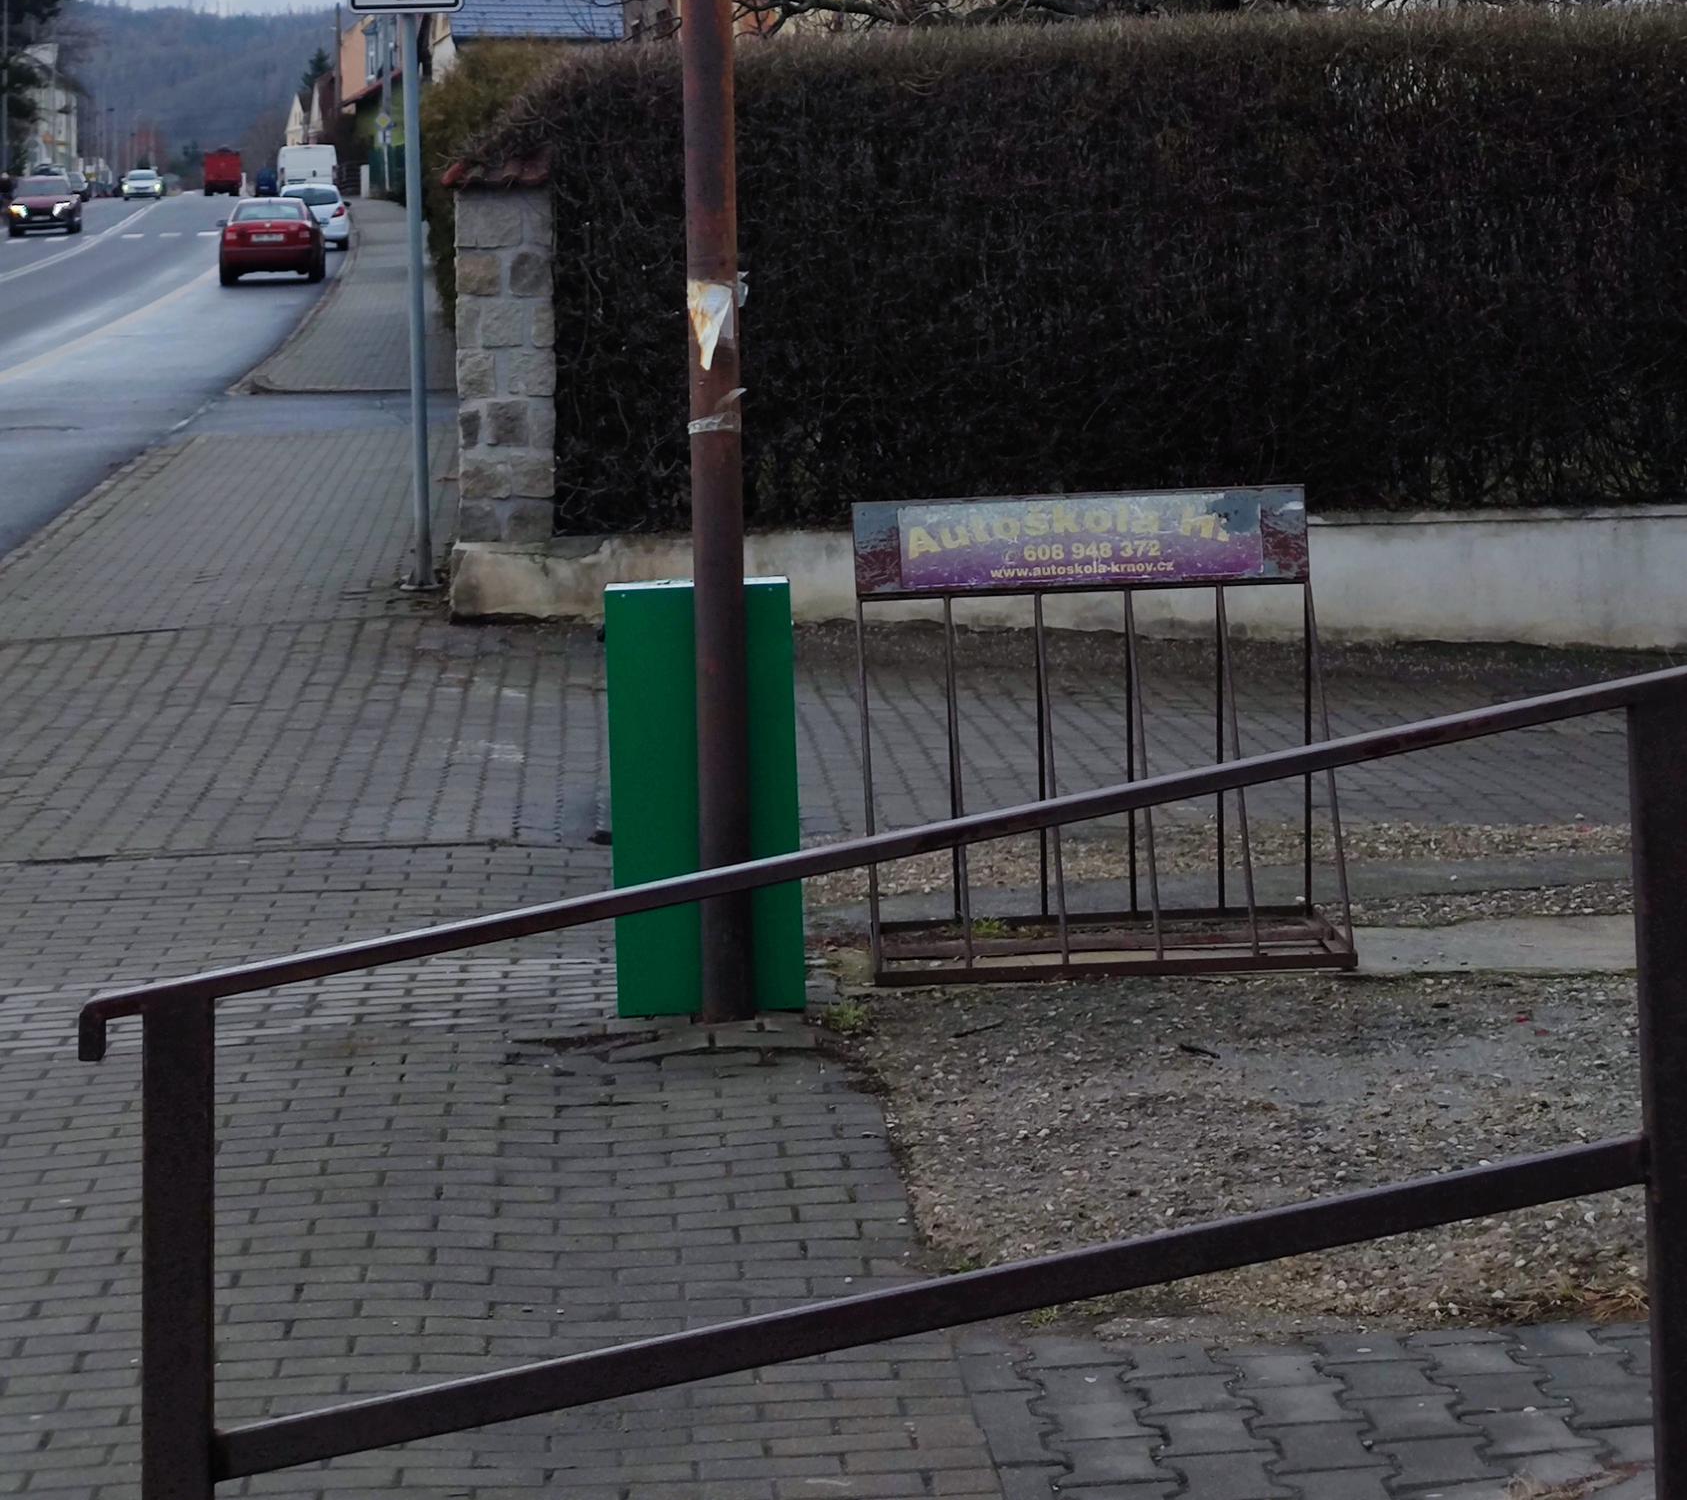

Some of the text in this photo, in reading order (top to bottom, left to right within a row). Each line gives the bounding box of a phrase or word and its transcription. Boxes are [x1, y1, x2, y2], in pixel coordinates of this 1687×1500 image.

[907, 502, 1160, 560] Autoškola
[1023, 539, 1161, 562] 608 948 372
[990, 560, 1175, 579] www.autoskola-krnov.cz
